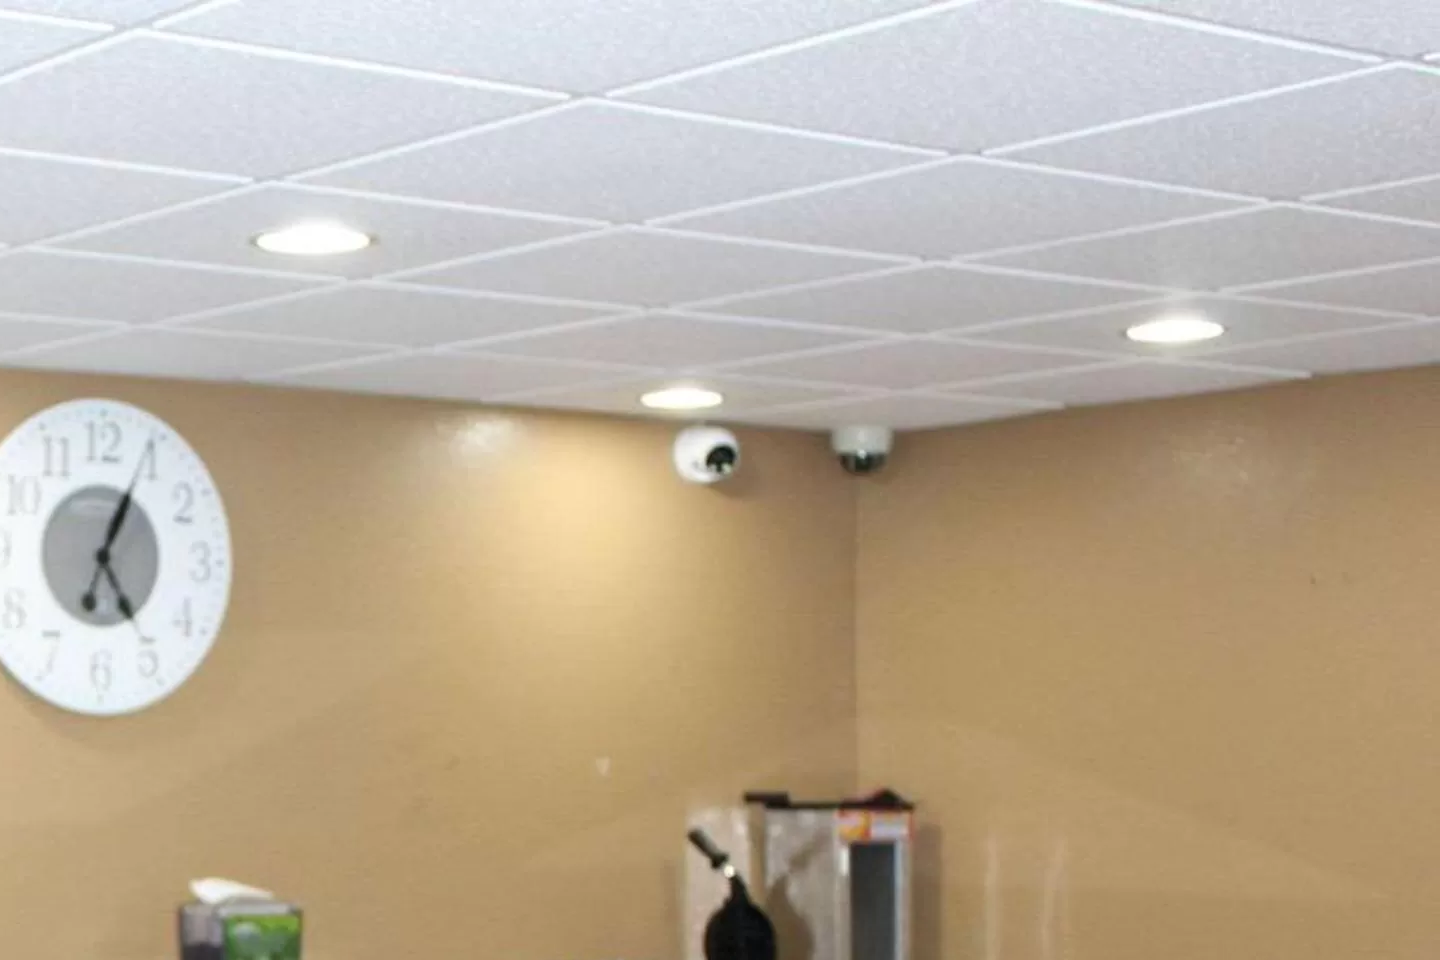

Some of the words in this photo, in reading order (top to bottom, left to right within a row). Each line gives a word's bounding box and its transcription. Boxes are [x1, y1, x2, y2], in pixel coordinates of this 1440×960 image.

[42, 435, 71, 479] 11
[83, 419, 123, 464] 12
[140, 436, 158, 481] 1
[7, 474, 42, 517] 10
[170, 480, 195, 525] 2
[188, 540, 212, 584] 3
[2, 587, 28, 630] 8
[171, 596, 192, 638] 4
[41, 628, 62, 674] 7
[89, 648, 112, 692] 6
[137, 634, 159, 679] 5
